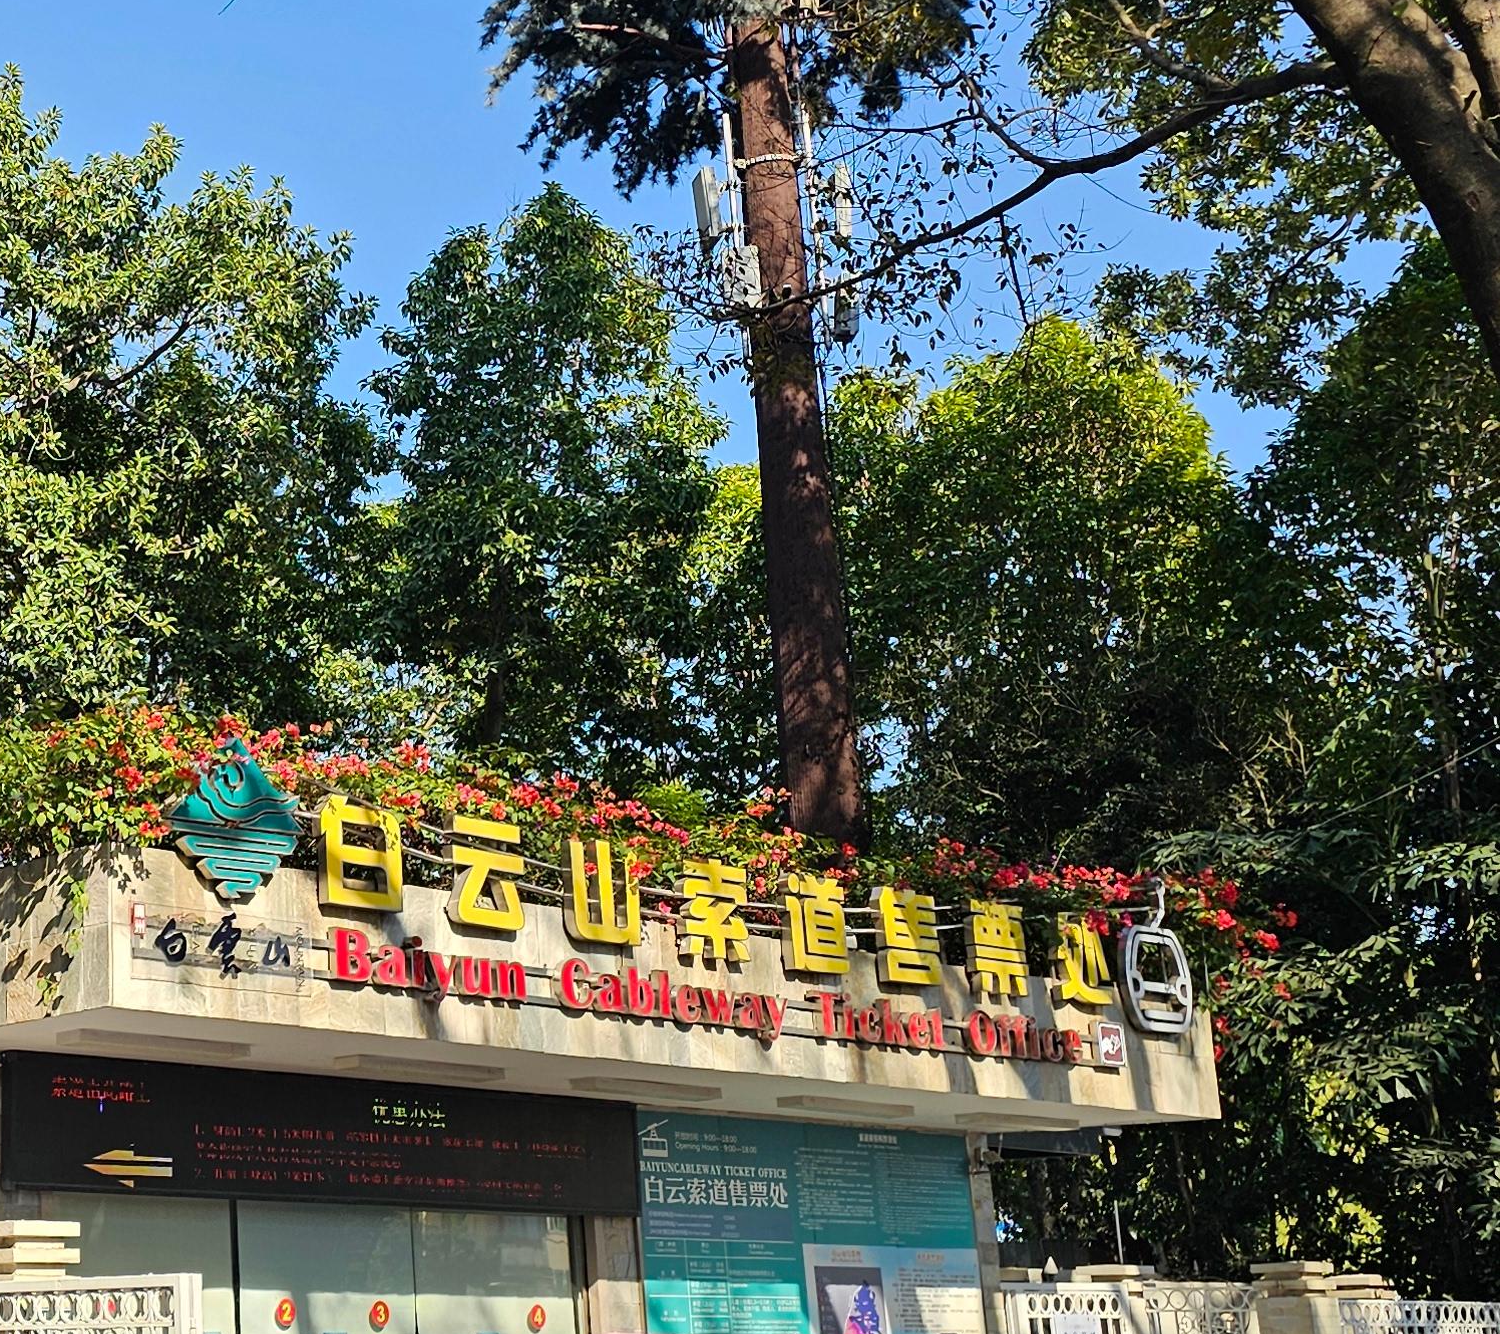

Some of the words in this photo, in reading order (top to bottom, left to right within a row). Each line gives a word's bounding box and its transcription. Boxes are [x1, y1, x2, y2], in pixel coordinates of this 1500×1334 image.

[317, 794, 1113, 1005] 白云山索道售票处
[330, 927, 528, 1002] Baiyun
[554, 957, 788, 1042] Cableway
[815, 991, 945, 1049] Ticket
[966, 1010, 1084, 1063] Office
[640, 1160, 721, 1176] BAIYUNCABLEWAY
[724, 1165, 755, 1177] TICKET
[758, 1167, 787, 1179] OFFICE
[644, 1176, 789, 1209] 白云索道售票处
